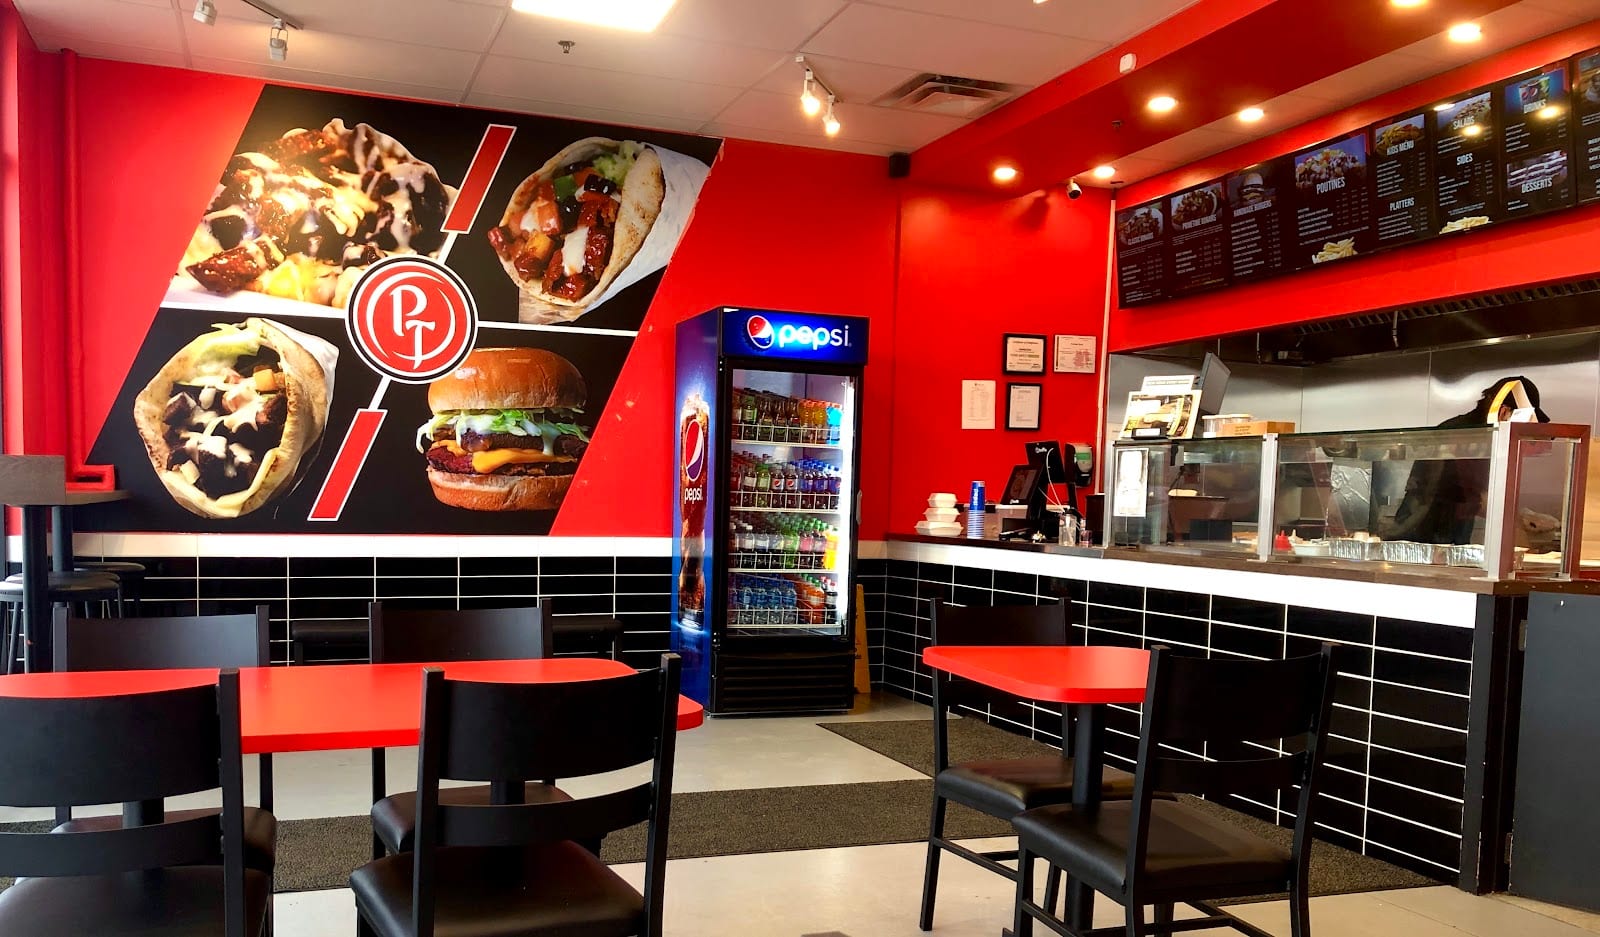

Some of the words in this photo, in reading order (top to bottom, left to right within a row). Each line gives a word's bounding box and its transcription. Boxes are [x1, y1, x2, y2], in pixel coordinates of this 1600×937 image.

[1452, 115, 1475, 130] SALADS
[1399, 139, 1414, 152] MENU
[1456, 153, 1473, 165] SIDES
[1316, 176, 1346, 195] POUTINES
[1521, 177, 1552, 193] DESSERTS
[1389, 197, 1415, 212] PLATTERS
[778, 324, 850, 350] pepsi
[684, 484, 702, 505] pepsi
